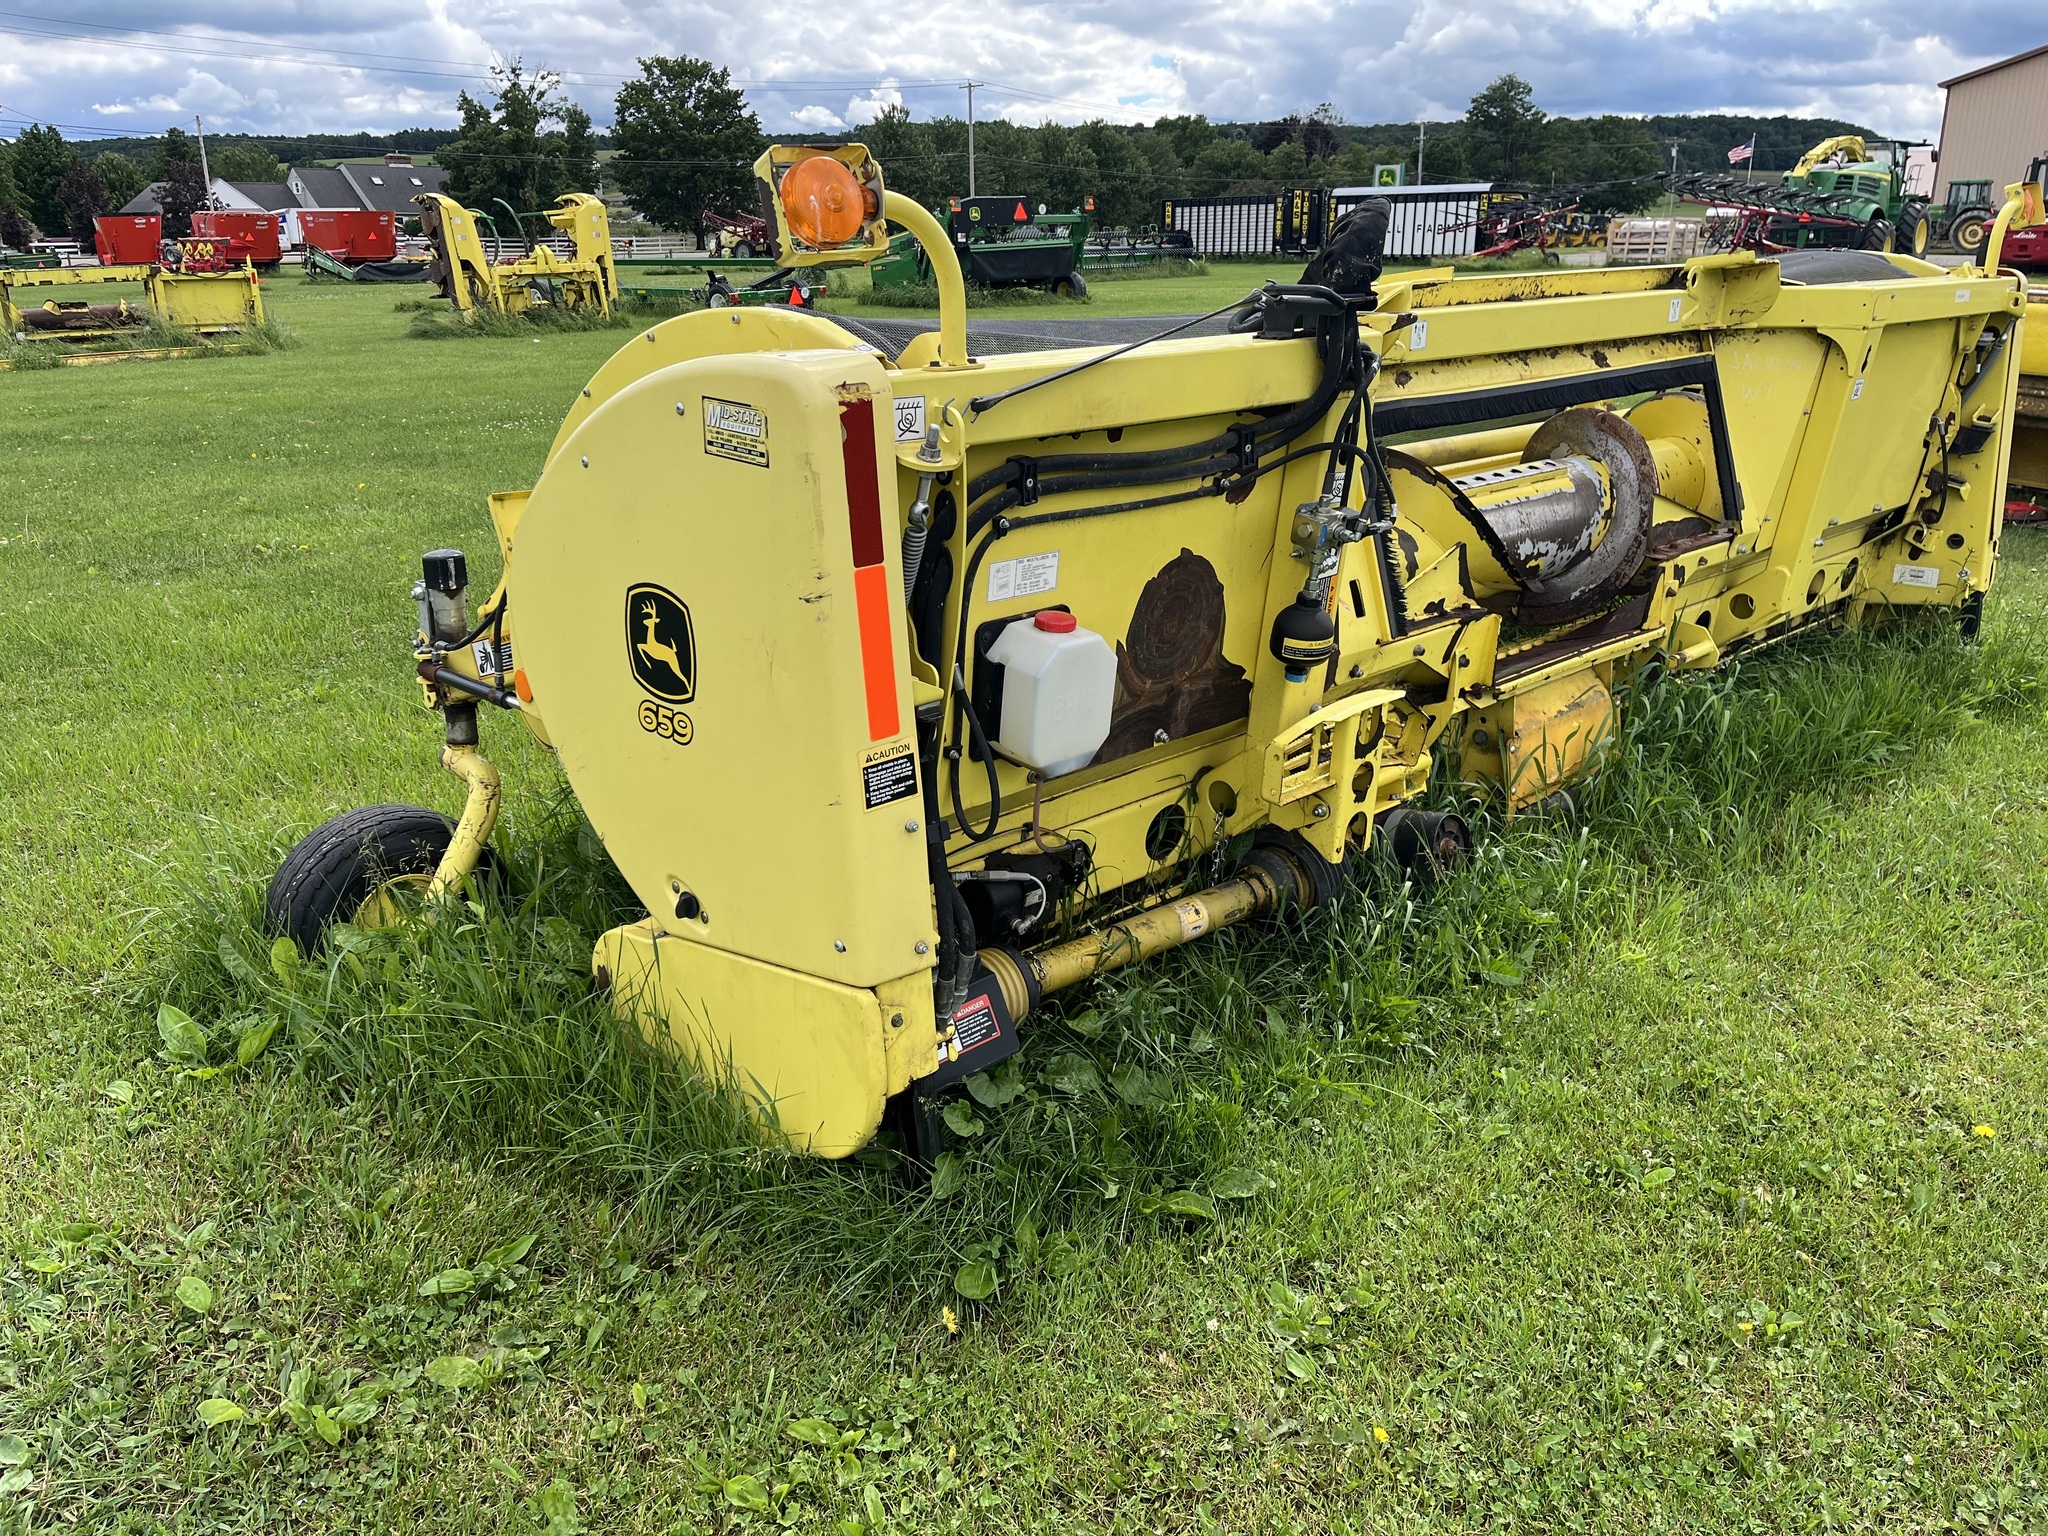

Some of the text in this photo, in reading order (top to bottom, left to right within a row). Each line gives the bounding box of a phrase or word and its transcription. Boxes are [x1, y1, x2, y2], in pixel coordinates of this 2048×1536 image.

[1728, 350, 1804, 374] JACKSN
[707, 403, 762, 429] MID-STATE
[723, 422, 758, 434] EQUIPMENT
[638, 699, 694, 746] 659
[873, 743, 910, 761] CAUTION
[961, 1000, 984, 1014] DANGER
